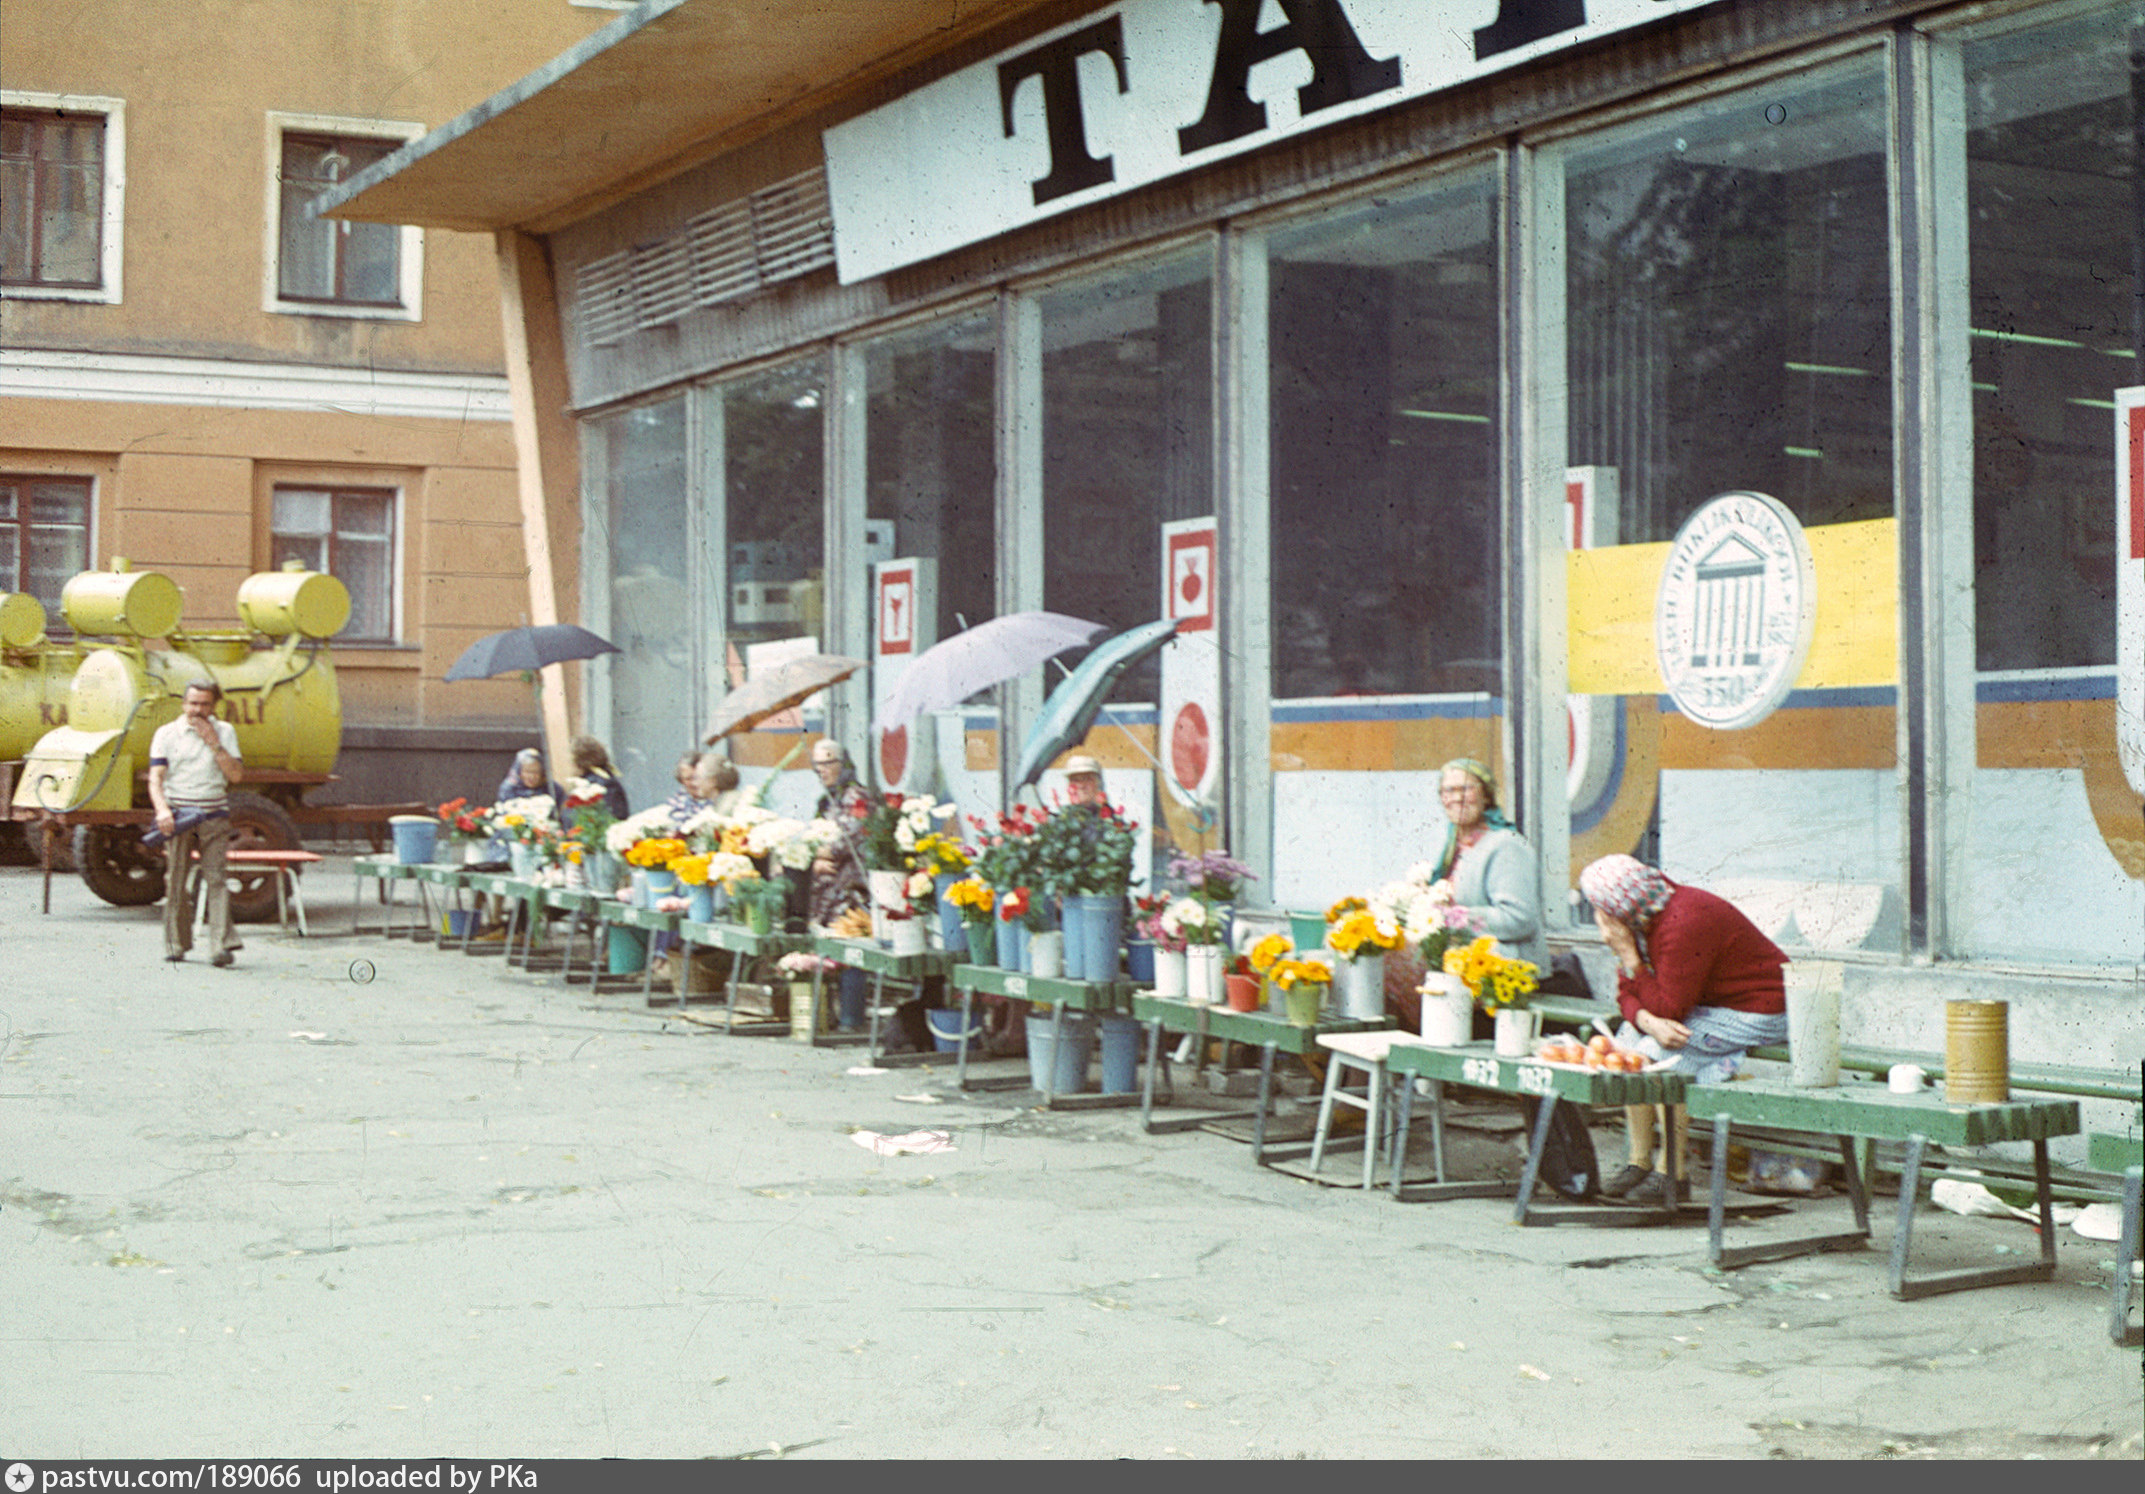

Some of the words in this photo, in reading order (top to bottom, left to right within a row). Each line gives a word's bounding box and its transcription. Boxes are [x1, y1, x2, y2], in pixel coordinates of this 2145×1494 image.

[998, 0, 1668, 206] TA
[40, 701, 69, 726] KA
[225, 697, 264, 724] ALI
